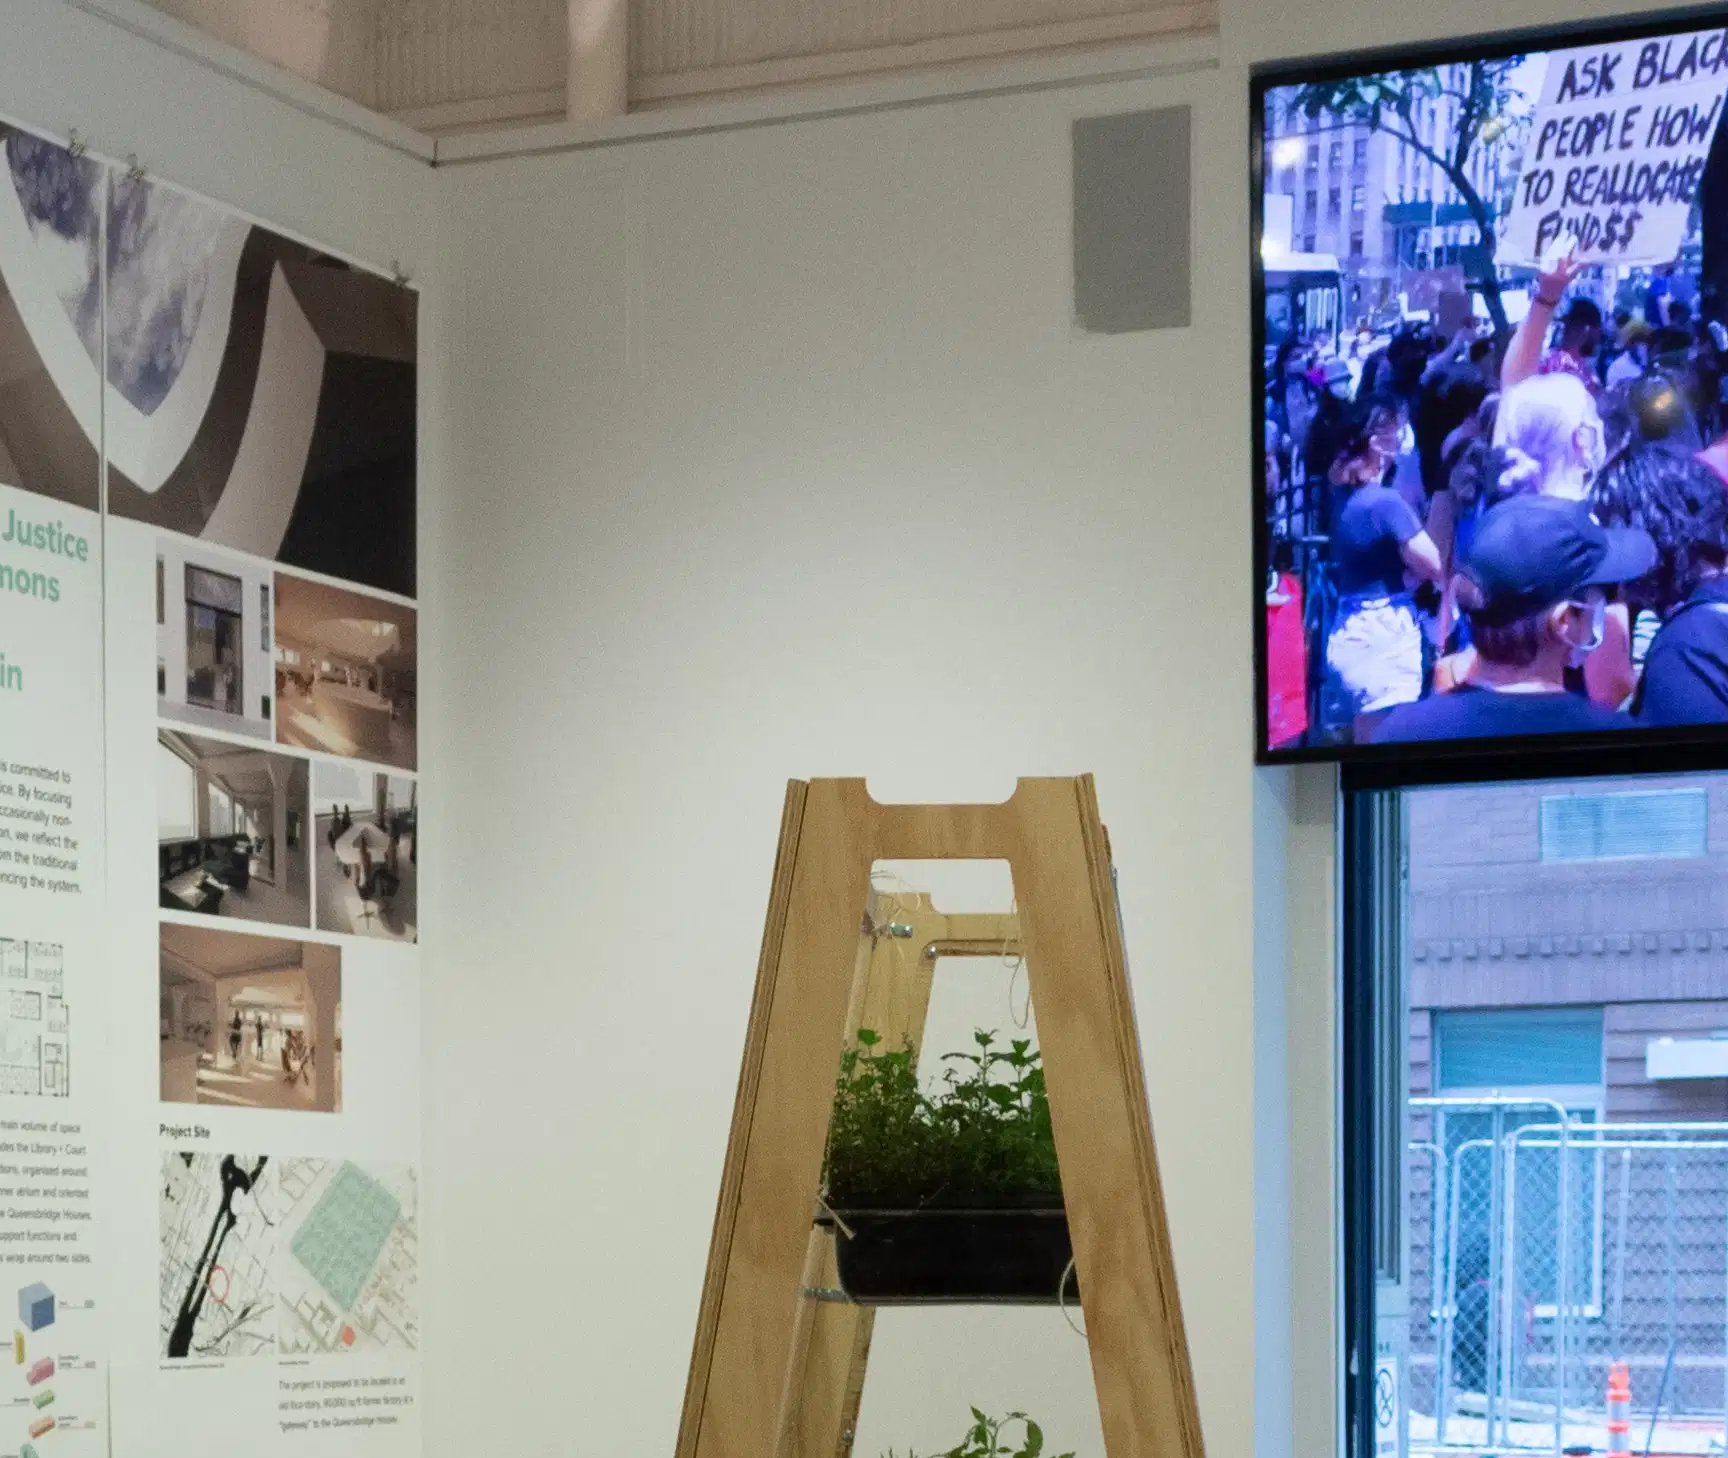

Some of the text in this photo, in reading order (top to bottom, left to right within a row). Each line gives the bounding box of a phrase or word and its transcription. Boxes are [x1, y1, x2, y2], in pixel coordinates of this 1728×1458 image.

[1556, 52, 1622, 104] ASK
[1536, 94, 1722, 162] PEOPLE HOW
[1523, 168, 1555, 208] TO
[1, 508, 89, 563] Justice
[0, 651, 23, 692] in
[159, 1123, 211, 1141] Project Site
